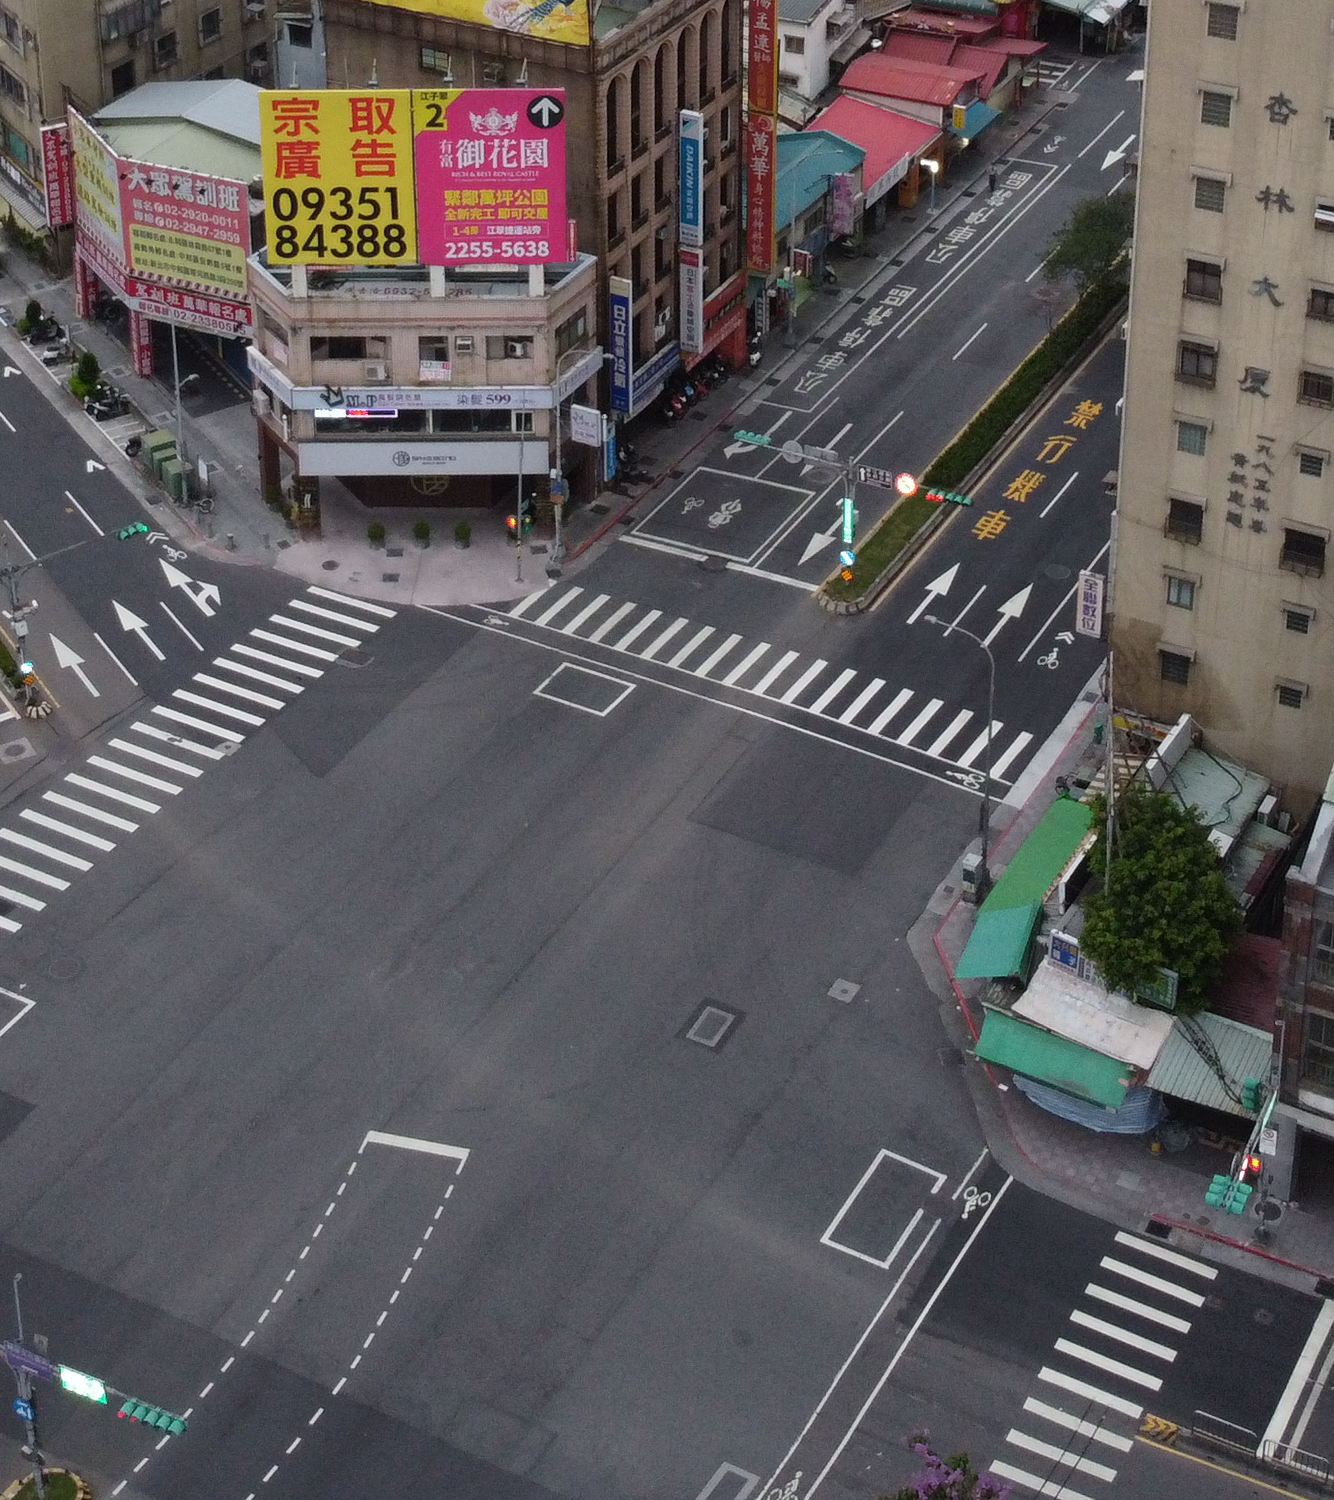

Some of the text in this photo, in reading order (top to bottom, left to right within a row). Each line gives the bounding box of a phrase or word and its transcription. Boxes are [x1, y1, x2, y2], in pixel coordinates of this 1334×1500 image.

[425, 103, 446, 128] 2
[456, 138, 549, 169] 御花園
[749, 132, 771, 181] 萬華
[273, 187, 400, 222] 09351
[165, 218, 240, 244] 02-2947-2959
[275, 223, 408, 259] 84388
[445, 240, 550, 259] 2255-5638
[485, 394, 511, 405] 599
[970, 399, 1103, 540] 禁行機車
